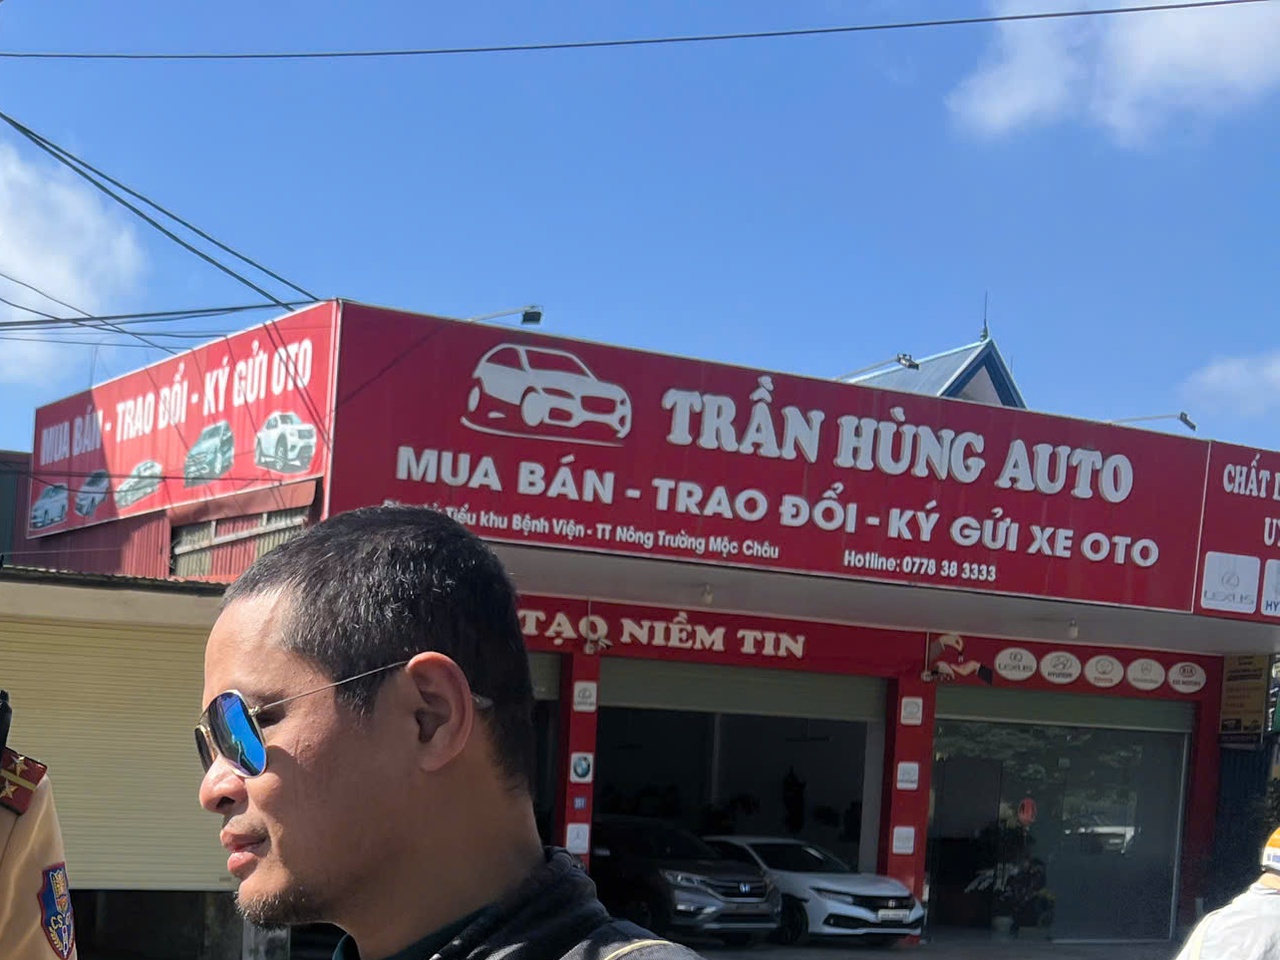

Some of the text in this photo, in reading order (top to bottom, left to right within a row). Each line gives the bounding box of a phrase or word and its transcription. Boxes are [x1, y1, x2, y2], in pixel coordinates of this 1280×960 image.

[40, 421, 70, 466] MUA
[72, 404, 104, 456] BÁN
[116, 392, 155, 443] TRAO
[203, 356, 230, 417] KÝ
[271, 338, 313, 396] OTO
[662, 375, 1134, 503] TRẦN HÙNG AUTO
[1223, 453, 1271, 498] CHẤT
[396, 445, 502, 492] MUA
[517, 454, 615, 504] BÁN
[652, 478, 768, 522] TRAO
[780, 482, 857, 534] ĐỔI
[887, 500, 942, 543] KÝ
[950, 507, 1019, 551] GỬI
[1027, 525, 1073, 558] XE
[1081, 532, 1160, 567] OTO
[480, 509, 507, 529] khu
[512, 513, 549, 536] Bệnh
[552, 518, 585, 540] Viện
[595, 523, 612, 540] TT
[616, 526, 654, 549] Nông
[658, 530, 705, 554] Trường
[709, 536, 738, 557] Mộc
[742, 540, 779, 559] Châu
[844, 549, 997, 581] Hotline: 0778 38 3333
[518, 608, 806, 659] TẠO NIỀM TIN
